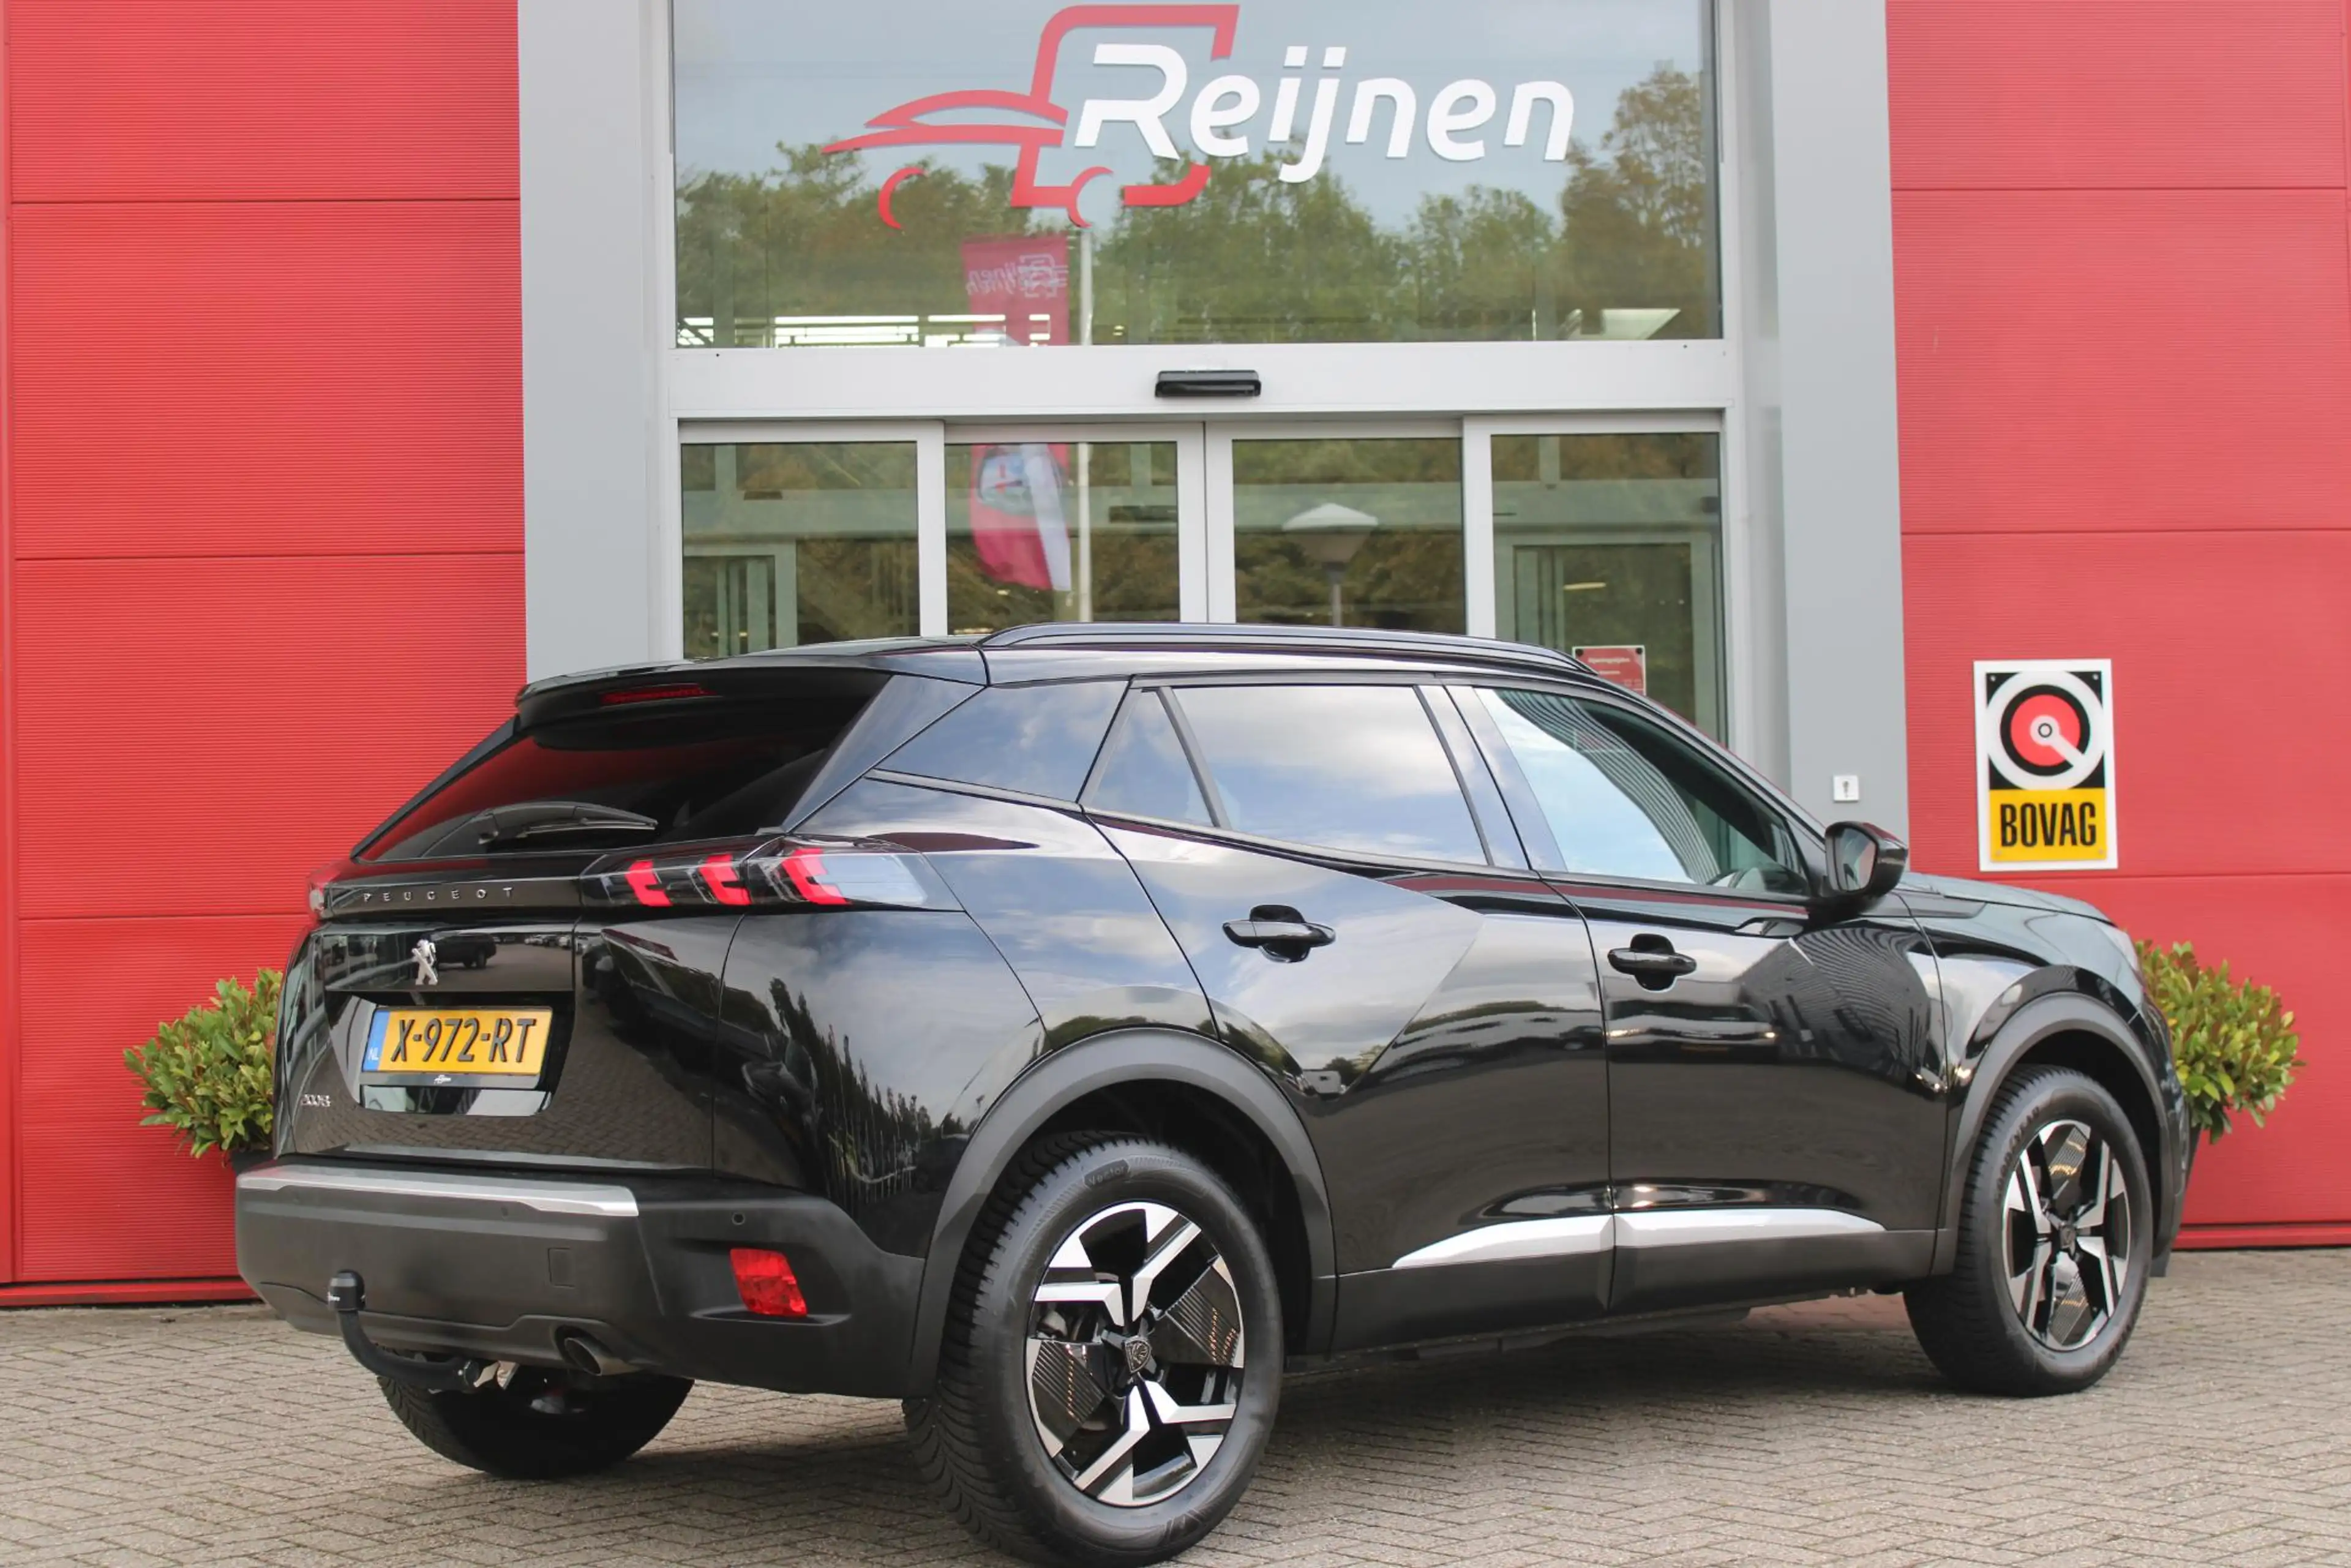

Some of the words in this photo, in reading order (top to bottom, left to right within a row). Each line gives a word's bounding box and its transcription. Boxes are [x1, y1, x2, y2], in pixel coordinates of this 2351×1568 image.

[1074, 43, 1574, 183] Reijnen
[2000, 801, 2096, 847] BOVAG
[363, 887, 512, 902] PEUGEOT
[368, 1046, 379, 1060] NL
[391, 1018, 537, 1063] X-972-RT
